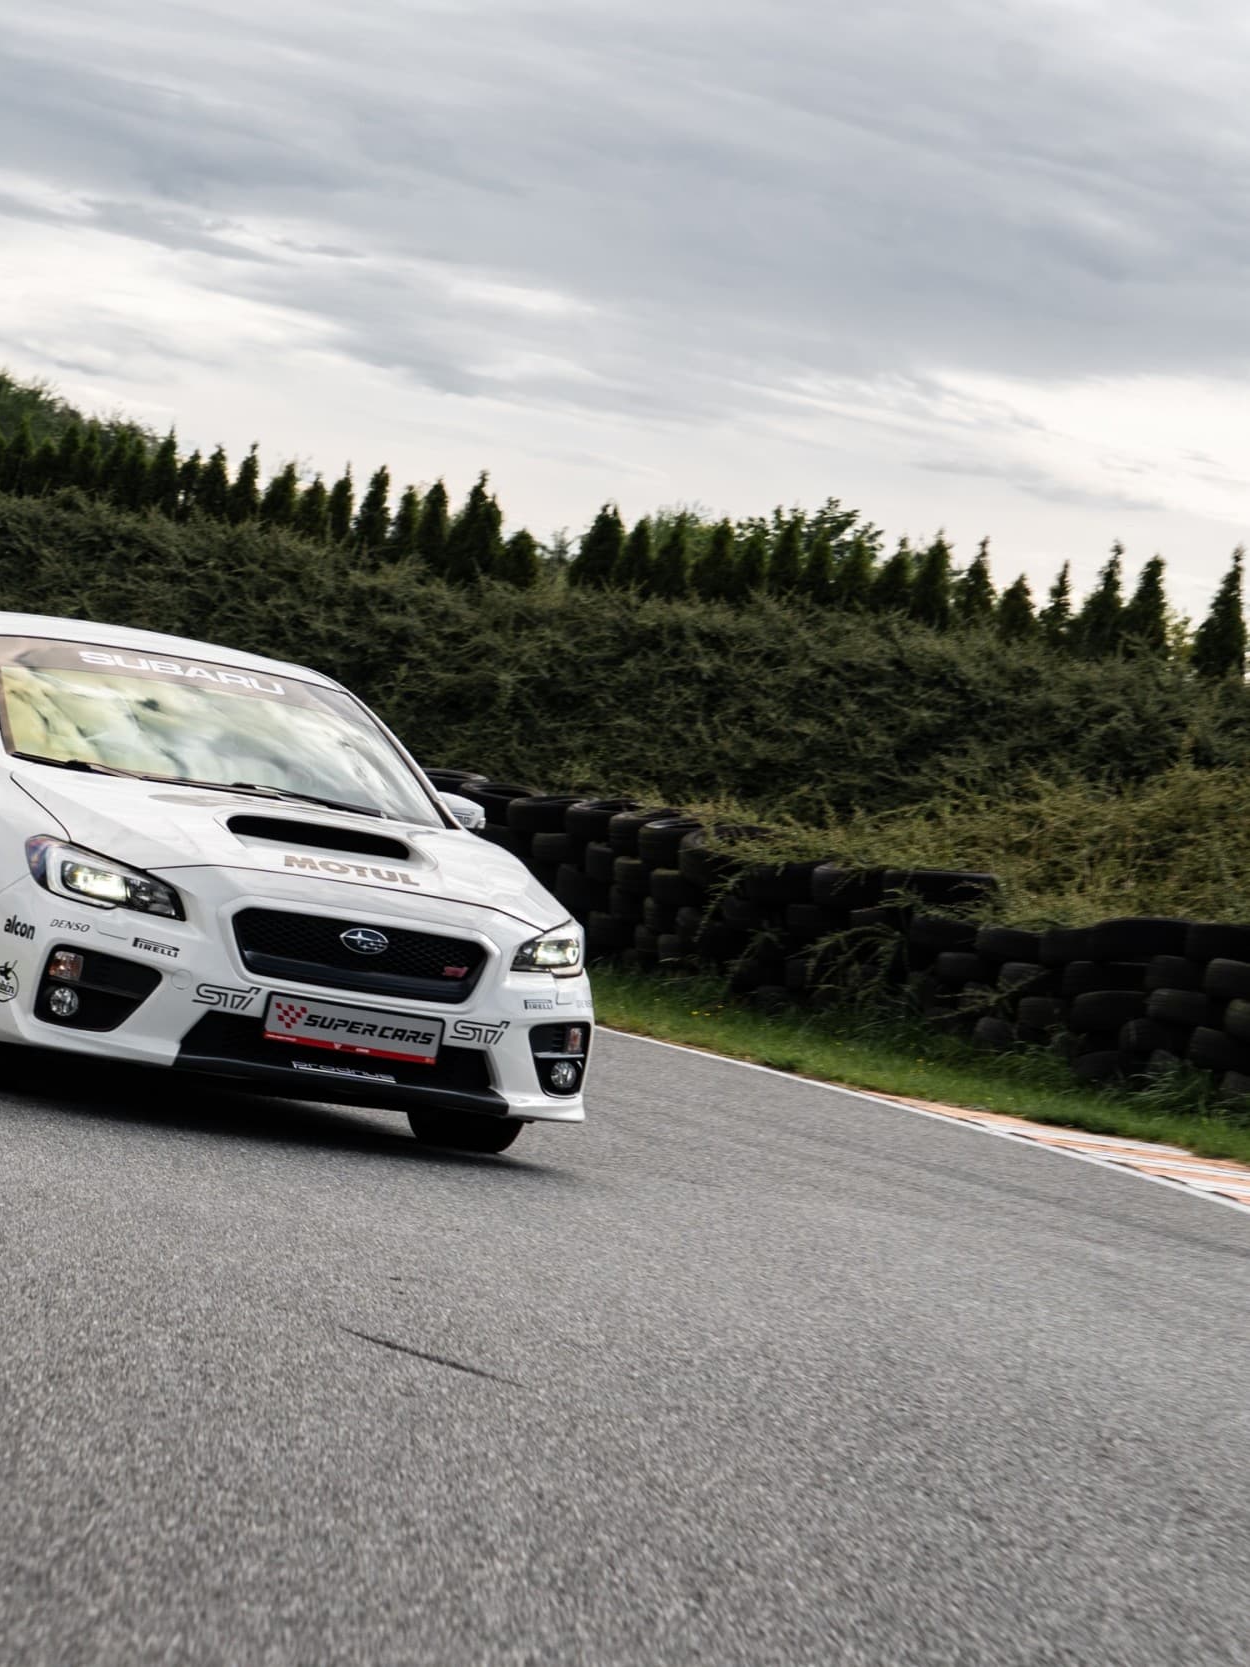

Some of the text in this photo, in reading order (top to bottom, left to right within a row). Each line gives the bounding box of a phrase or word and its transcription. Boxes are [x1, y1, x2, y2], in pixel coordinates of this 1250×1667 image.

[78, 651, 286, 696] SUBARU
[284, 855, 420, 886] MOTUL
[4, 915, 35, 940] alcon
[50, 918, 90, 933] DENSO
[132, 937, 180, 958] PIRELLI
